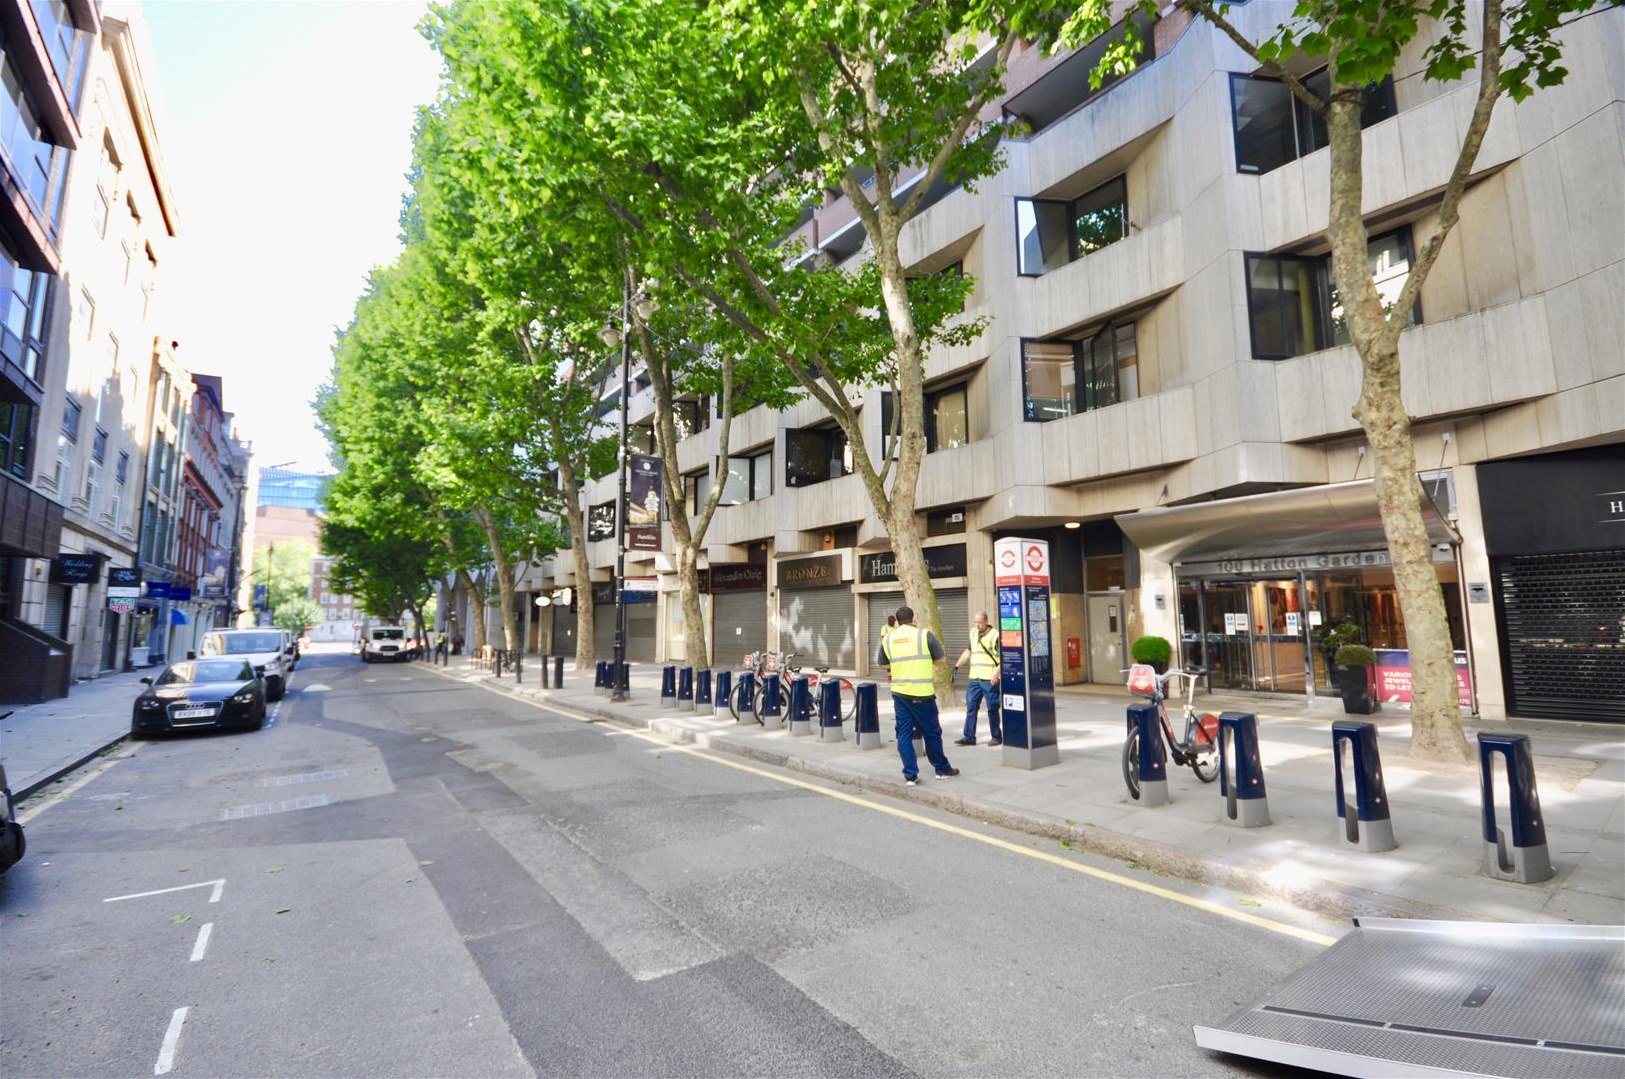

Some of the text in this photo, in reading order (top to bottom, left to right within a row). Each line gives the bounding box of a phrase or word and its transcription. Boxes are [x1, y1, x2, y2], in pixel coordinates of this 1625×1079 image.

[1217, 551, 1388, 574] 100 Hatton Garden
[786, 565, 829, 581] BRONZE
